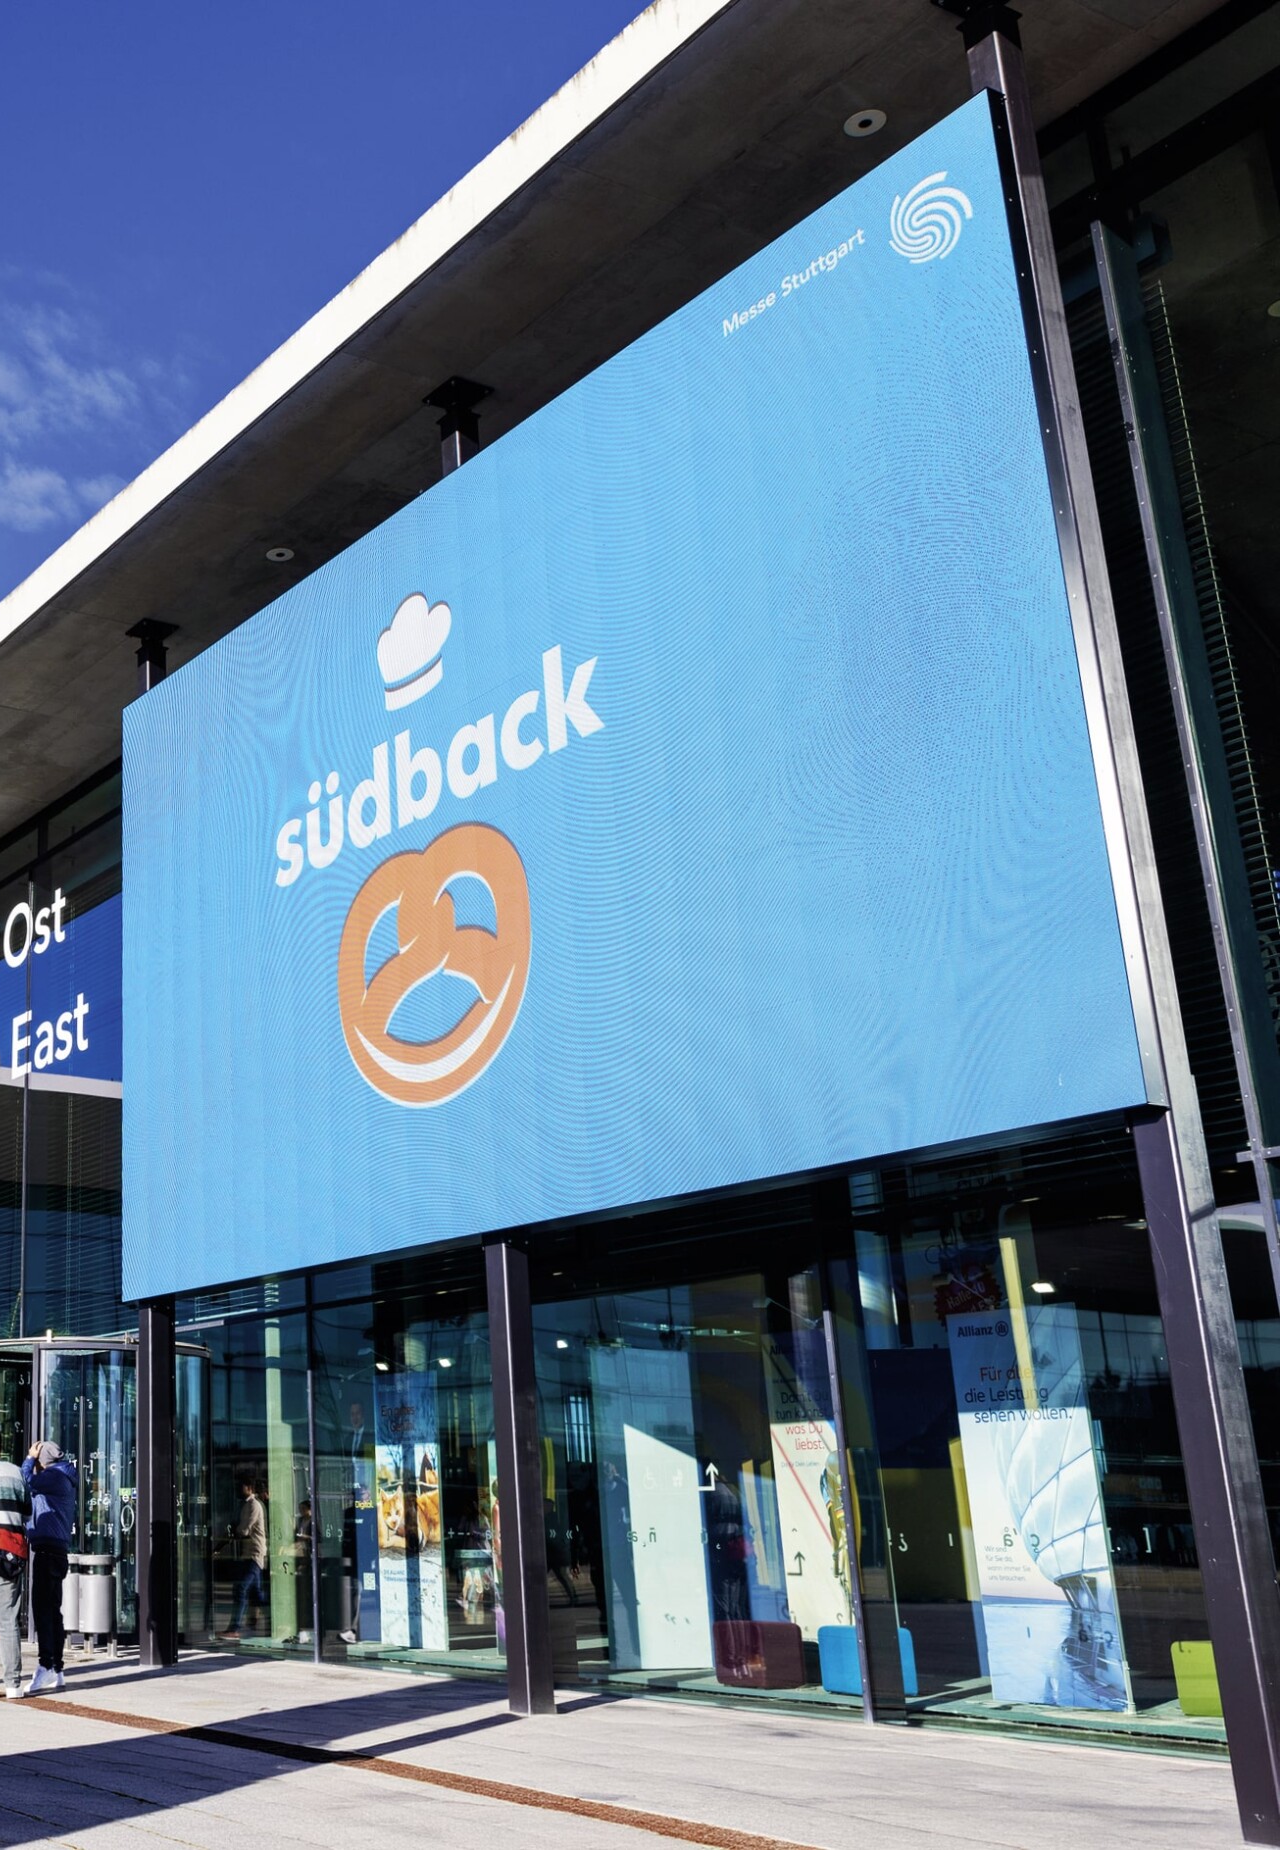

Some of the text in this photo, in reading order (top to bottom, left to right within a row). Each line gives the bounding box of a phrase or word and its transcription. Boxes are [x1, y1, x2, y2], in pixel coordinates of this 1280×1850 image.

[722, 228, 866, 337] Messe Stuttgart
[275, 643, 606, 888] südback
[3, 887, 67, 968] Ost
[11, 992, 90, 1080] East
[957, 1325, 994, 1338] Allianz
[980, 1366, 1002, 1382] Für
[965, 1386, 1049, 1403] die Leistung
[775, 1409, 792, 1420] tun
[975, 1404, 1072, 1424] sehen wollen.
[785, 1420, 823, 1435] was Du
[795, 1438, 825, 1451] liebst.
